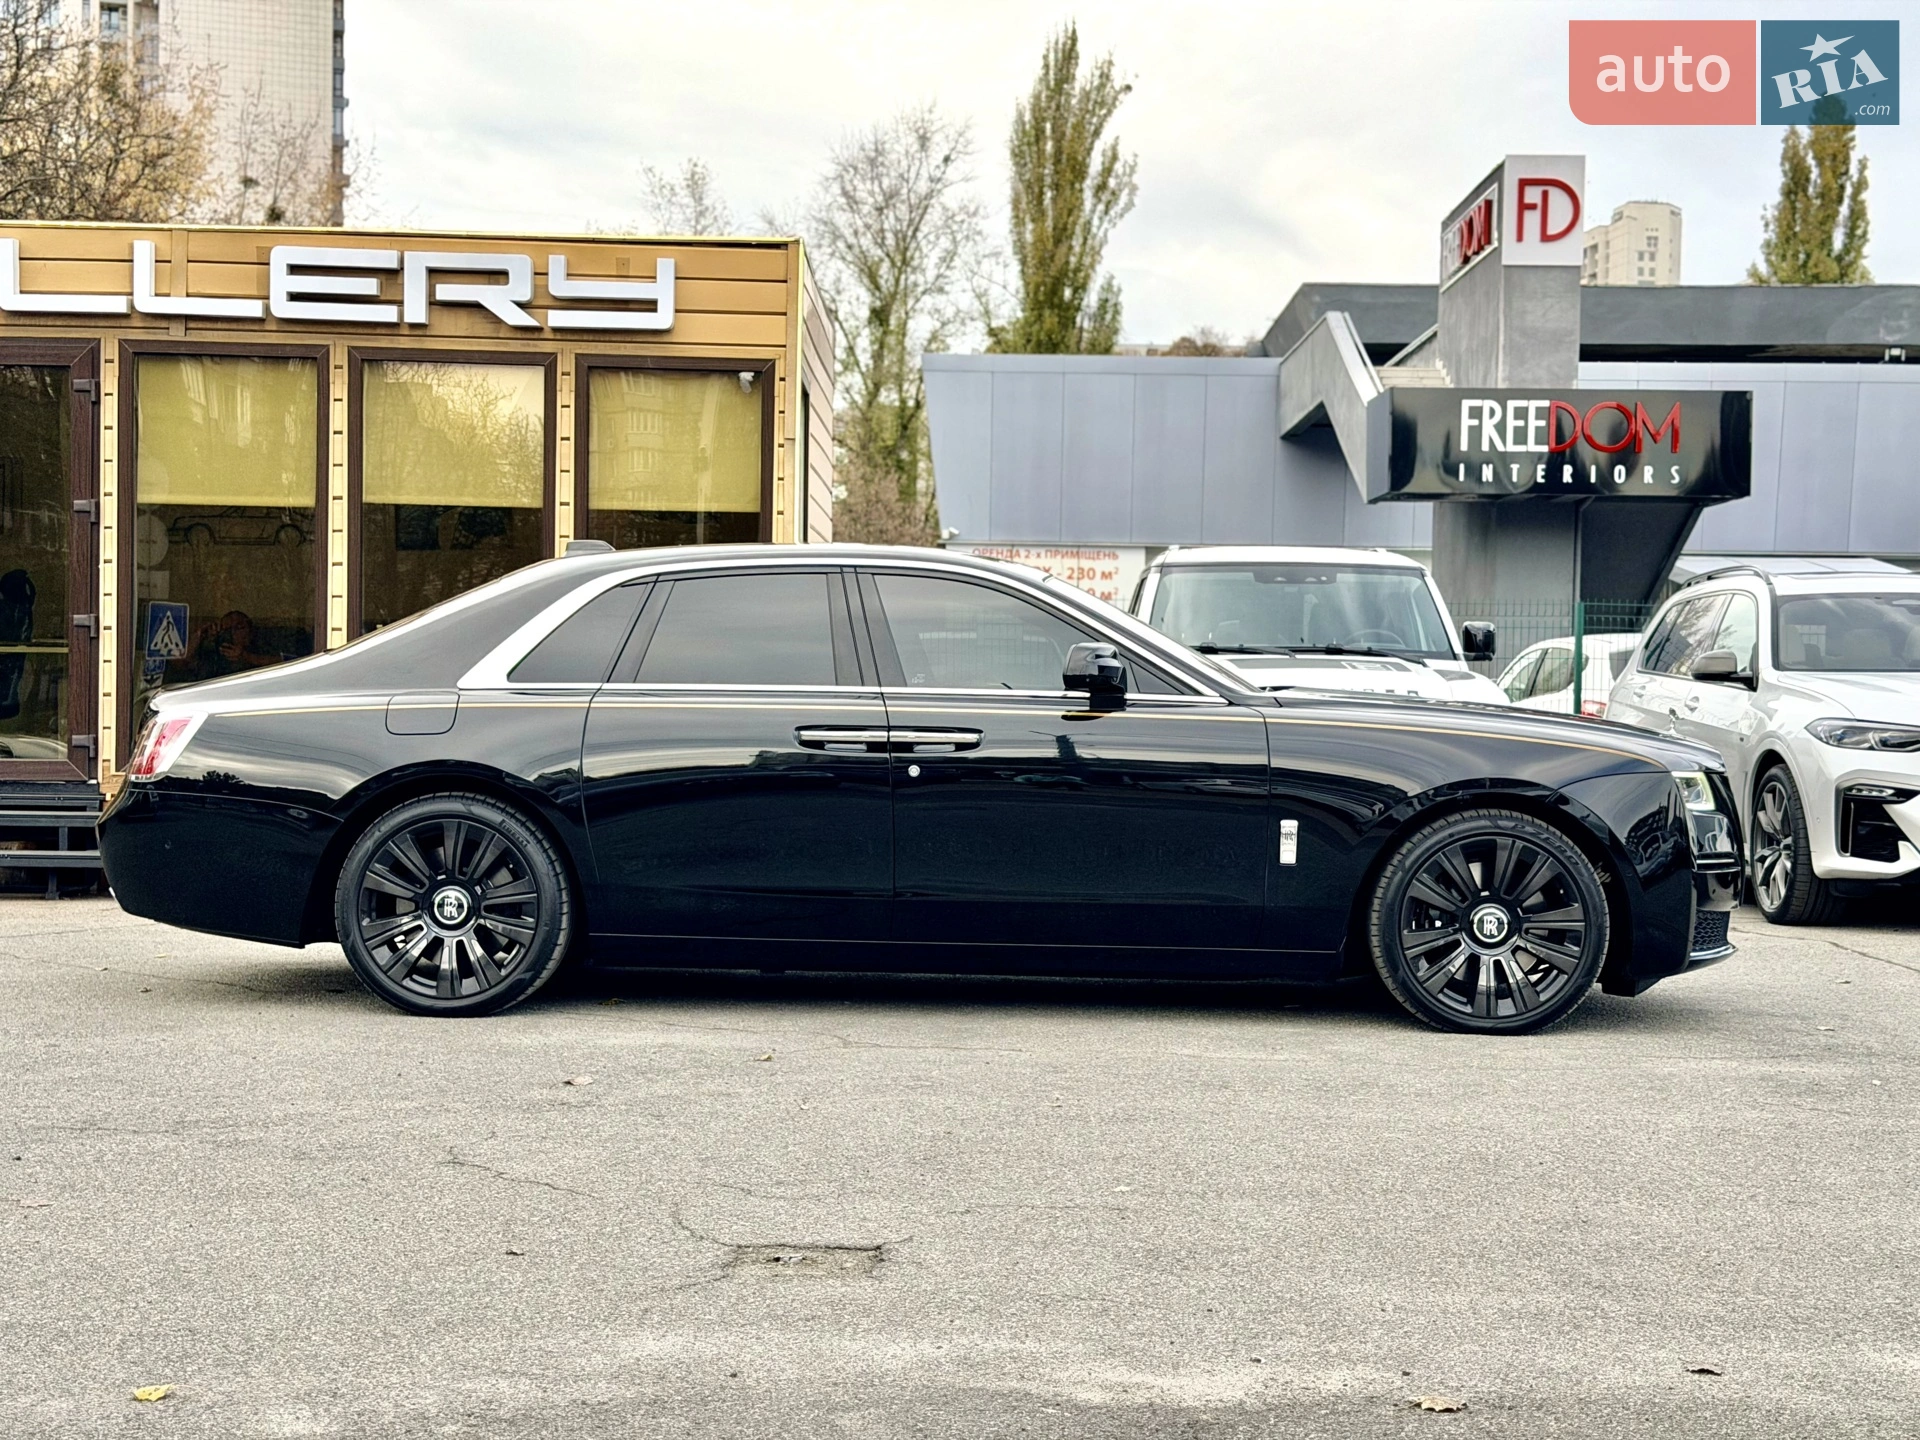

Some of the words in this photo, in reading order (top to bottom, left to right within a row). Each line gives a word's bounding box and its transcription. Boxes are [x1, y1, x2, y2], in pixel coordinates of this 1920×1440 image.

[1516, 178, 1581, 242] FD
[1460, 399, 1682, 453] FREEDOM
[1458, 462, 1681, 485] INTERIORS
[1044, 549, 1120, 561] ПРИМІЩЕНЬ
[1066, 566, 1097, 581] 230
